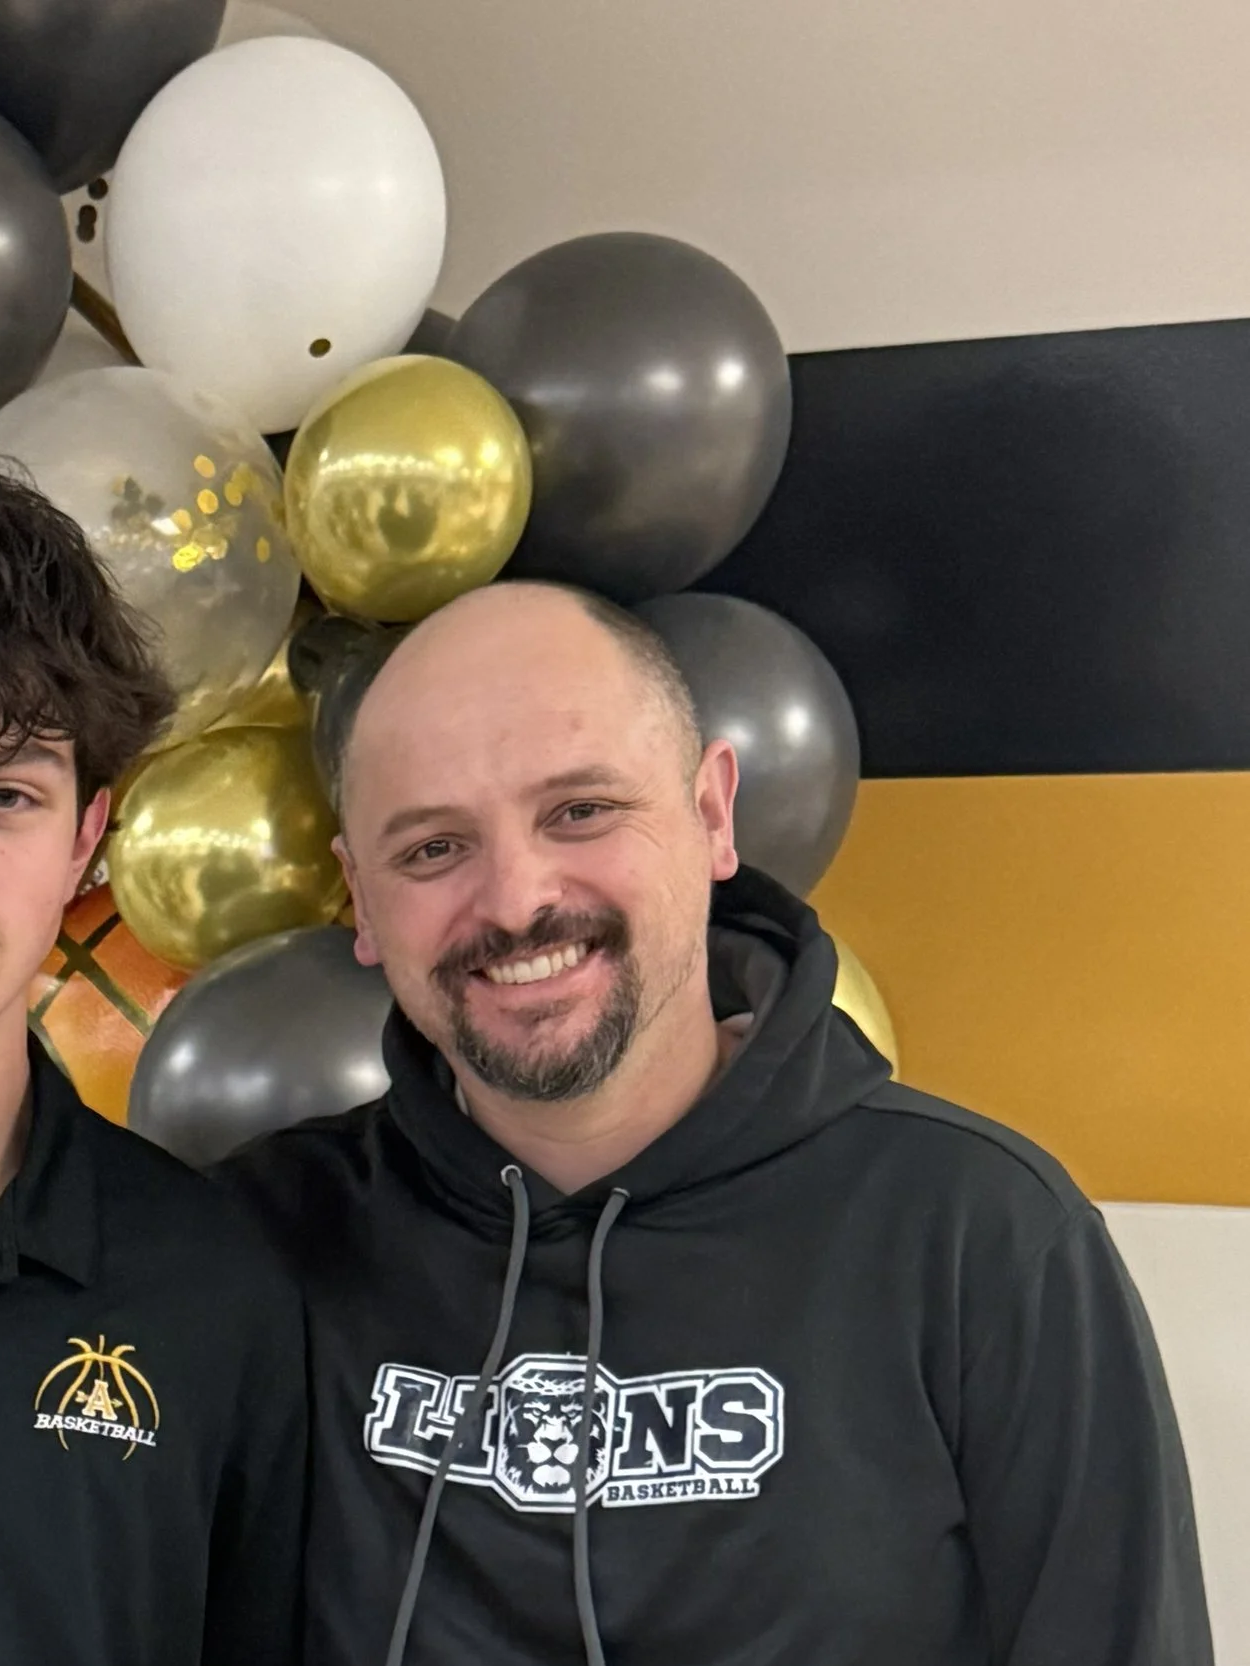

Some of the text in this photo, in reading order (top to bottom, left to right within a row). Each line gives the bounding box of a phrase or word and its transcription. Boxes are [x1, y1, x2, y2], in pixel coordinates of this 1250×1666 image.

[81, 1379, 118, 1421] A
[34, 1413, 156, 1447] BASKETBALL
[605, 1477, 757, 1503] BASKETBALL
